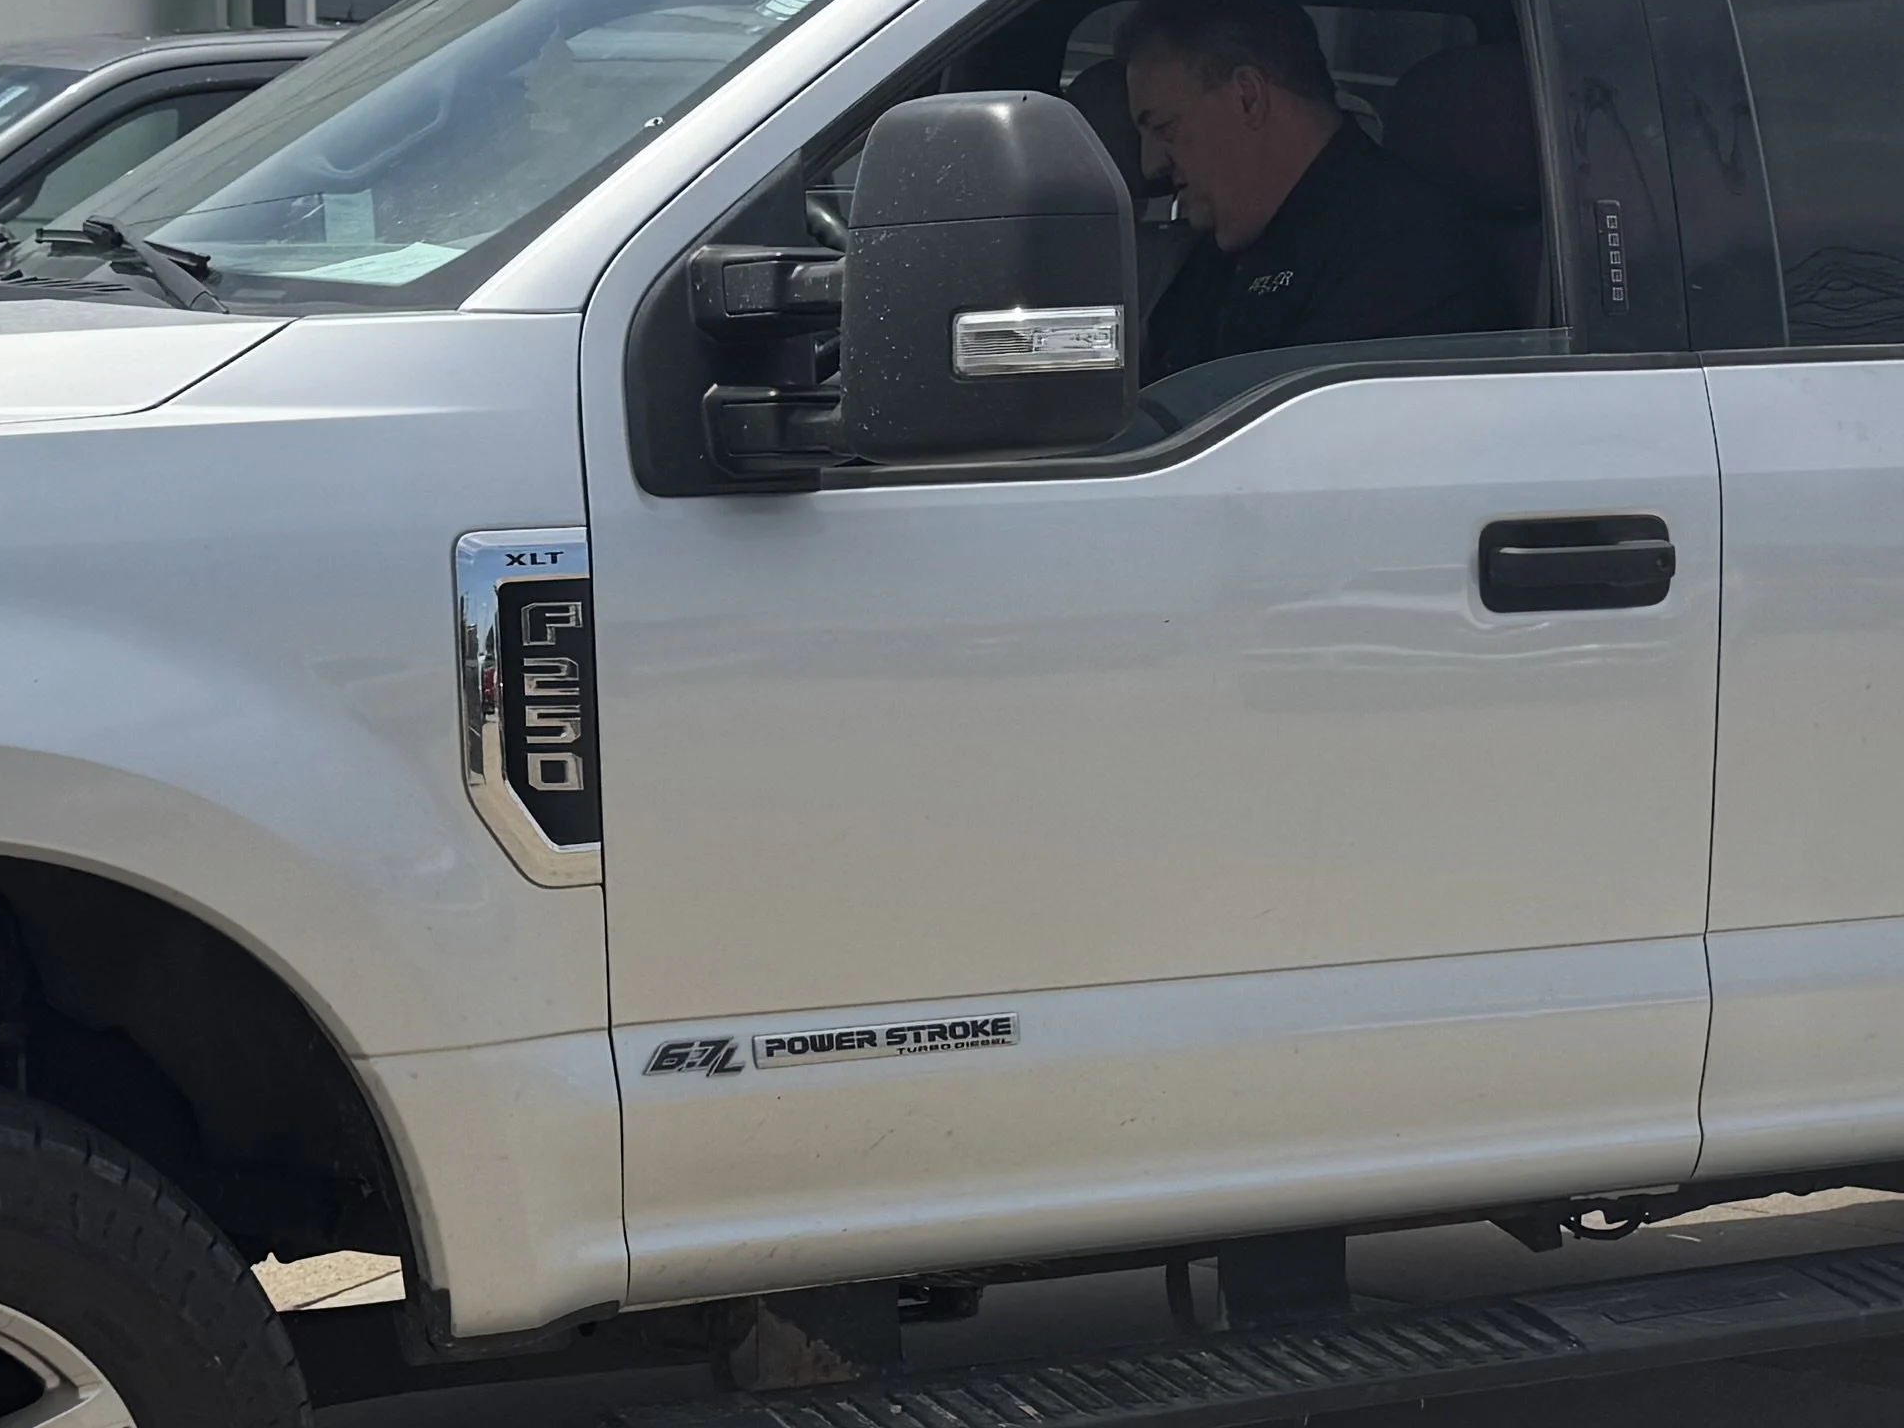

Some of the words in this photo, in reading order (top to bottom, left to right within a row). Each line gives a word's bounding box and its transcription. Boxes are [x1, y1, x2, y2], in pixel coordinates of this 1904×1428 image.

[504, 550, 565, 567] XLT
[520, 601, 585, 792] F250
[642, 1036, 747, 1078] 6.7L
[765, 1029, 878, 1058] POWER
[886, 1016, 1012, 1046] STROKE
[897, 1042, 951, 1055] TURBO
